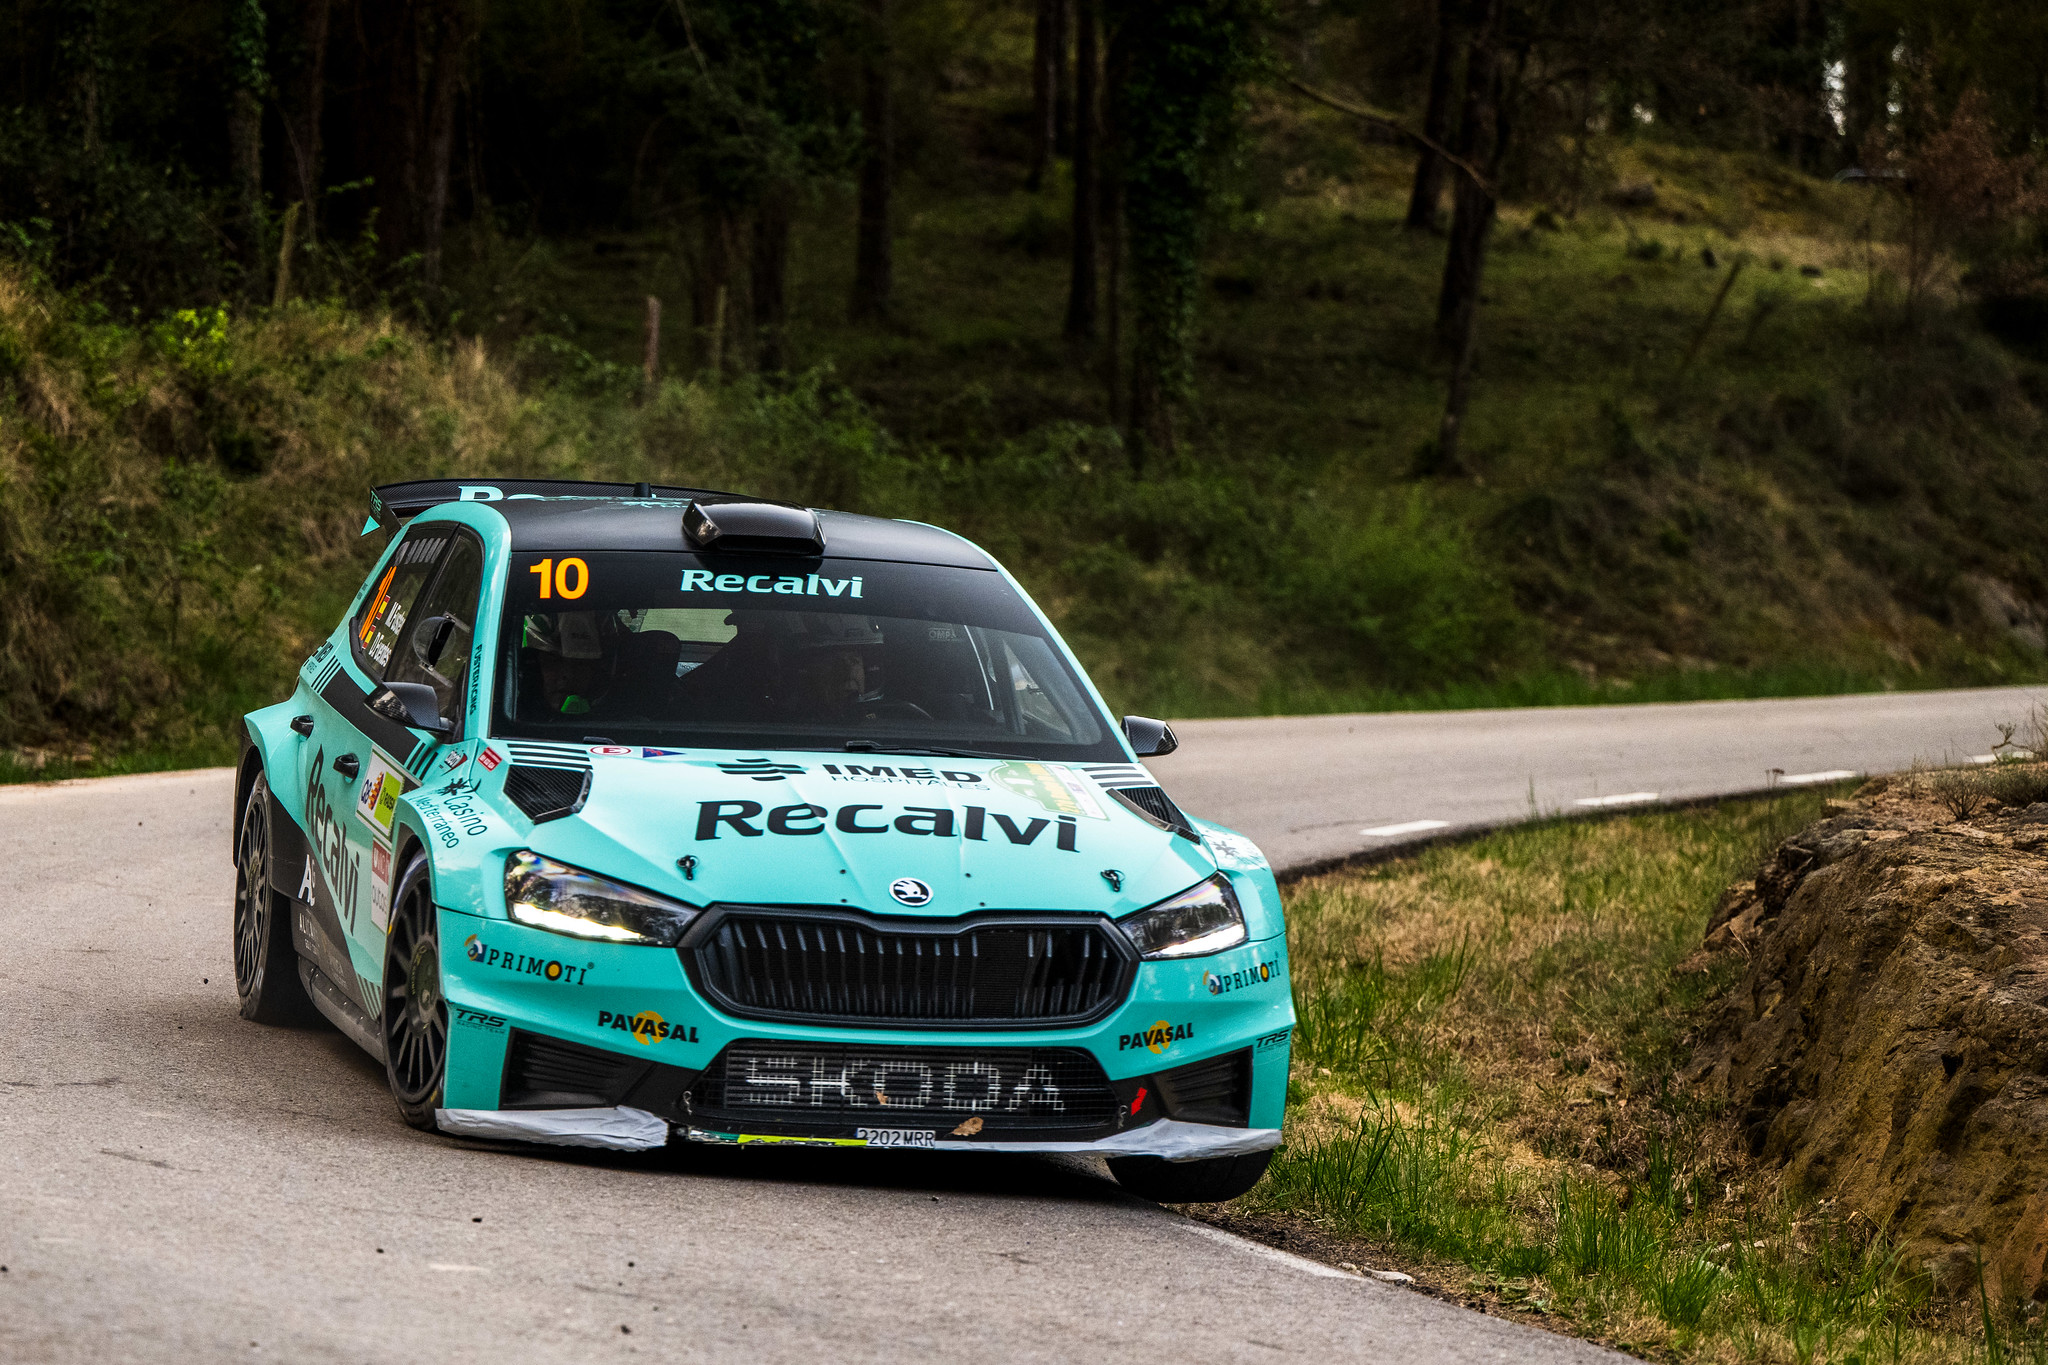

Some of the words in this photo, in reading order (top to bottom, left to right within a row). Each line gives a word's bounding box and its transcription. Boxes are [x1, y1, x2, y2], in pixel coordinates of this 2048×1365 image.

[529, 557, 590, 600] 10
[680, 569, 864, 598] Recalvi
[469, 643, 483, 716] FUSTERACING
[821, 763, 983, 783] IMED
[830, 775, 991, 791] HOSPITALES
[443, 795, 488, 836] Casino
[694, 799, 1081, 853] Recalvi
[305, 743, 360, 936] Recalvi
[487, 948, 588, 986] PRIMOTI
[1222, 957, 1281, 993] PRIMOTI
[456, 1008, 508, 1028] TRS
[597, 1010, 700, 1044] PAVASAL
[1119, 1021, 1195, 1052] PAVASAL
[1256, 1028, 1290, 1048] TRS
